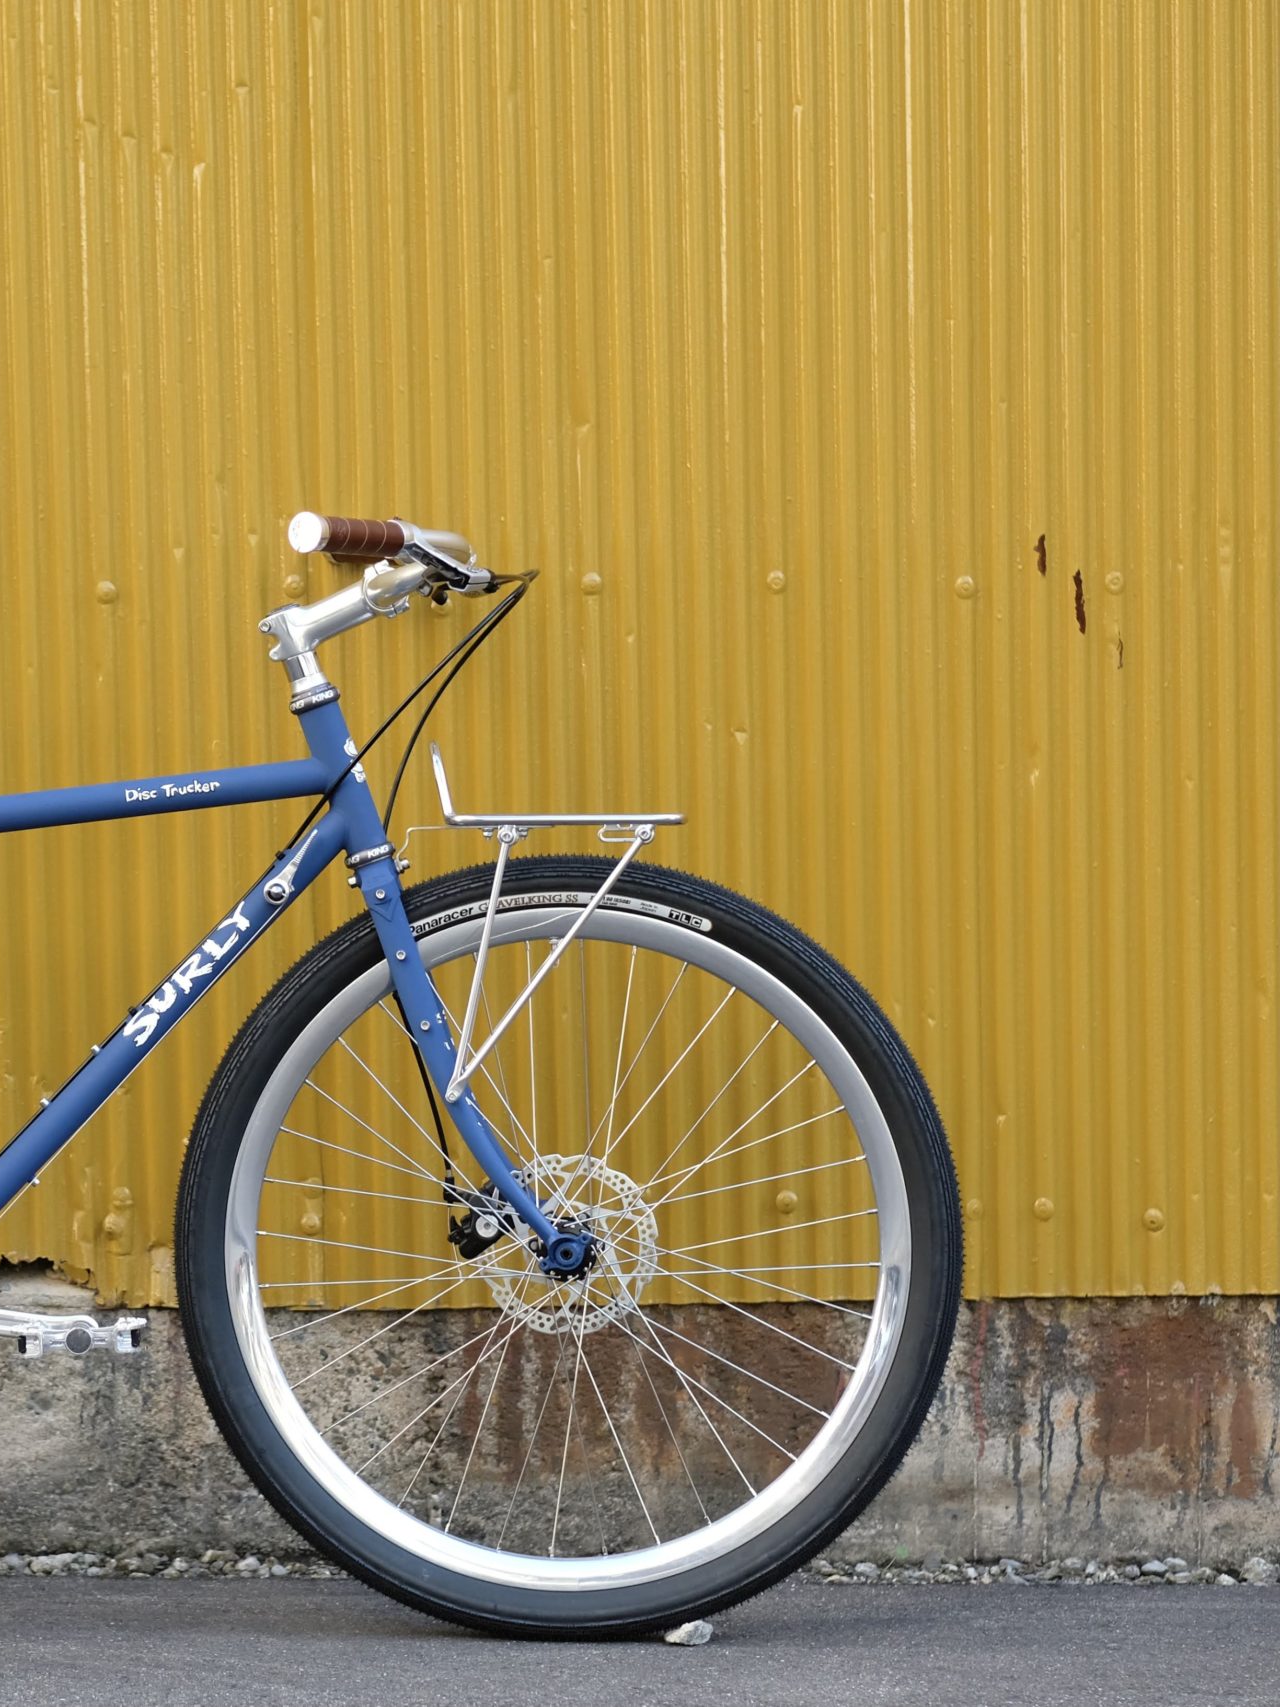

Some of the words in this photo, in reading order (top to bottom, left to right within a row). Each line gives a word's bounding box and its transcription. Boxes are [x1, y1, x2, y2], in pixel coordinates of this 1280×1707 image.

[312, 690, 334, 704] KING
[125, 787, 157, 803] Disc
[160, 779, 220, 798] Trucker
[367, 844, 389, 859] KING
[479, 894, 563, 912] GAVELKING
[566, 892, 579, 903] SS
[668, 909, 703, 929] TLC
[122, 900, 250, 1047] SURLY
